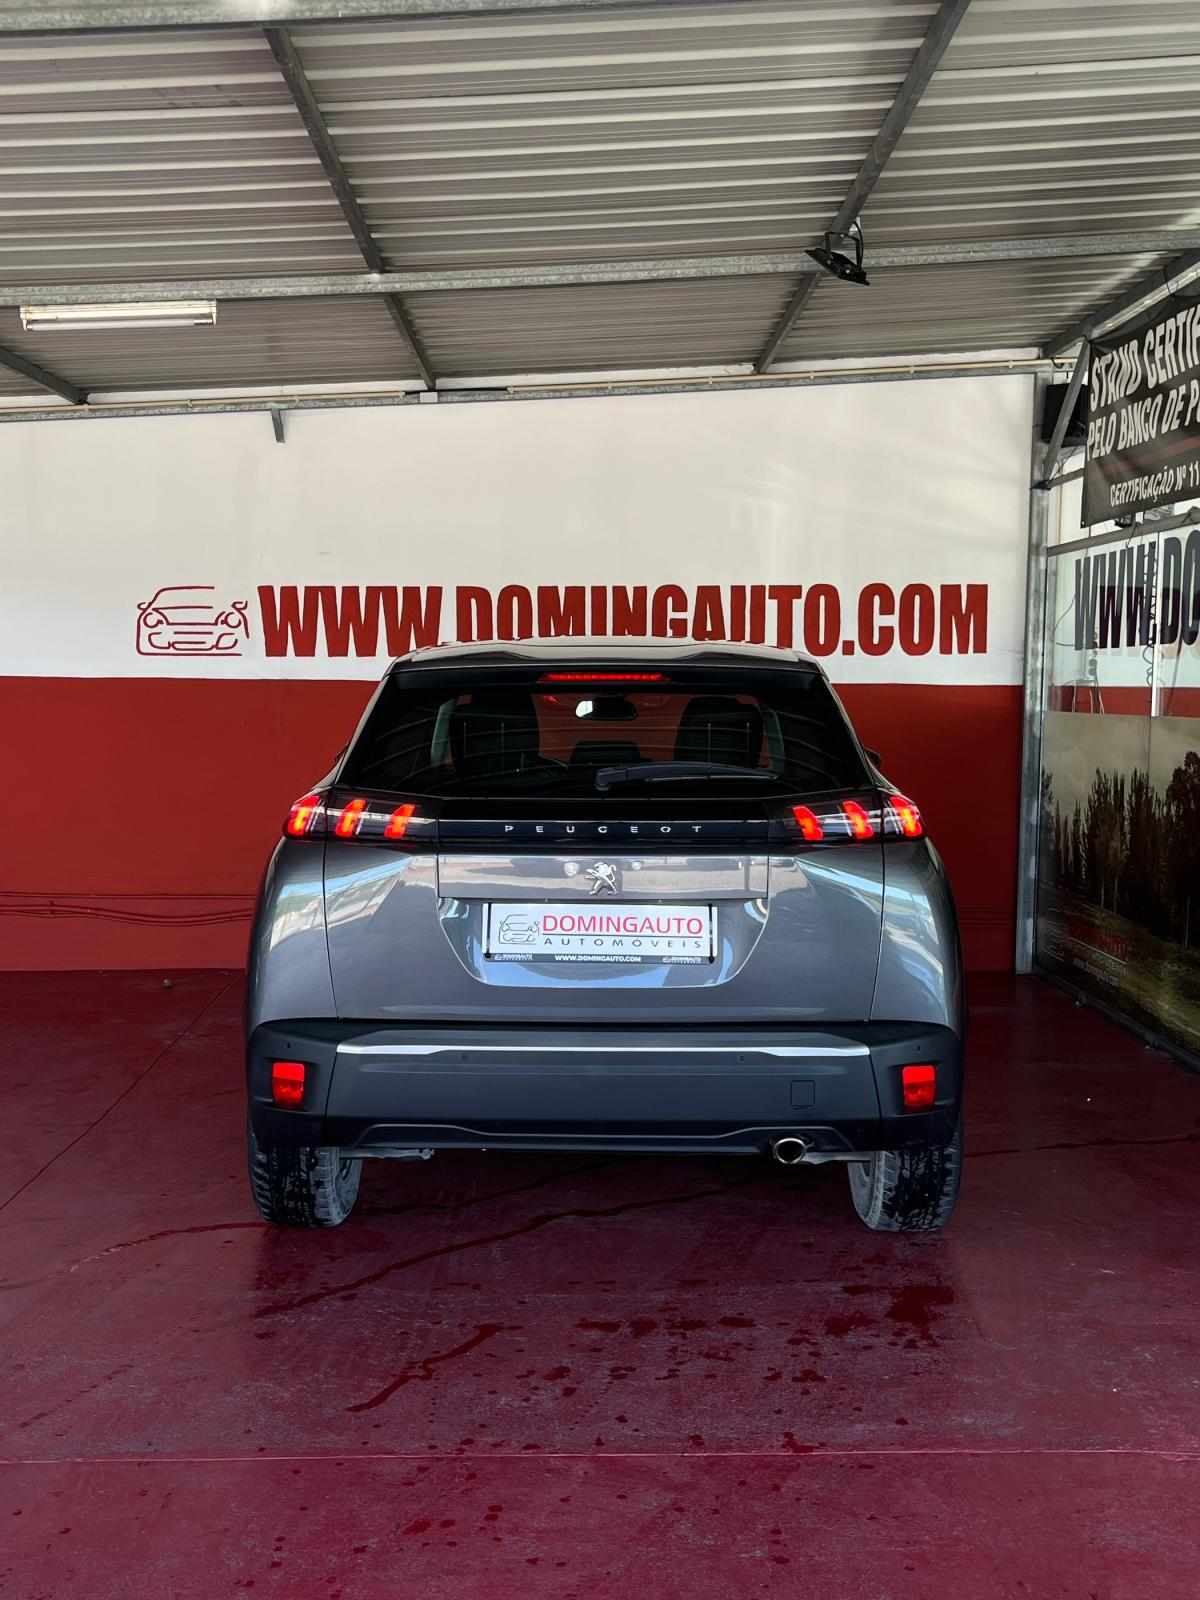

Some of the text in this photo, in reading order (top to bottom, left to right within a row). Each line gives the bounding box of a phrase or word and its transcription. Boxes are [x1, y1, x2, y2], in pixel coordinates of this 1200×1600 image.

[1090, 340, 1142, 412] STAND
[1087, 412, 1117, 461] PELO
[1117, 393, 1163, 451] BANCO
[1161, 384, 1186, 434] DE
[1110, 465, 1174, 507] CERTIFICAÇÃO
[1189, 461, 1200, 488] 11
[257, 583, 989, 657] WWWDOMINGAUTO.COM
[504, 825, 702, 834] PEUGEOT
[542, 914, 704, 935] DOMINGAUTO
[543, 937, 702, 949] AUTOMÓVEIS
